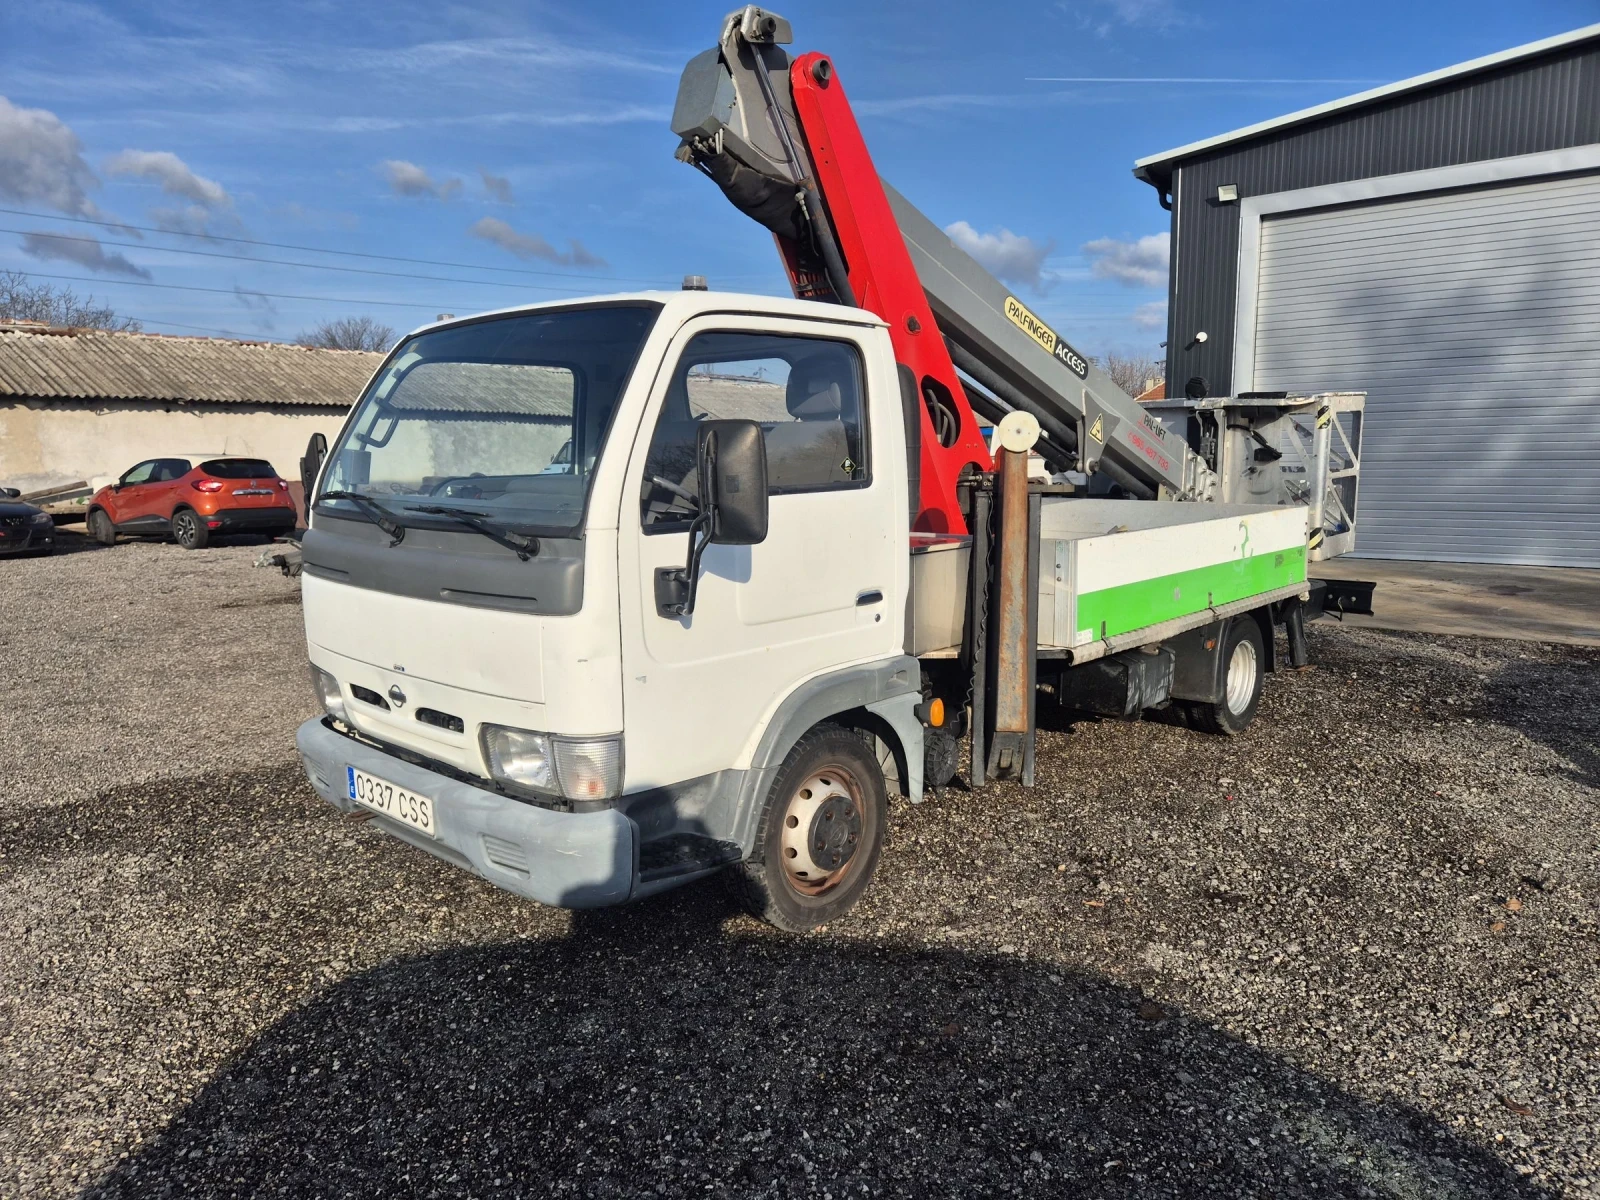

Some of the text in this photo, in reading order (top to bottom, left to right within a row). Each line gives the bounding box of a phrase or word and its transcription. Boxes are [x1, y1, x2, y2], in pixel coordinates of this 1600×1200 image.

[1008, 301, 1086, 375] PALFINGER ACCESS
[356, 774, 429, 828] 0337 CSS
